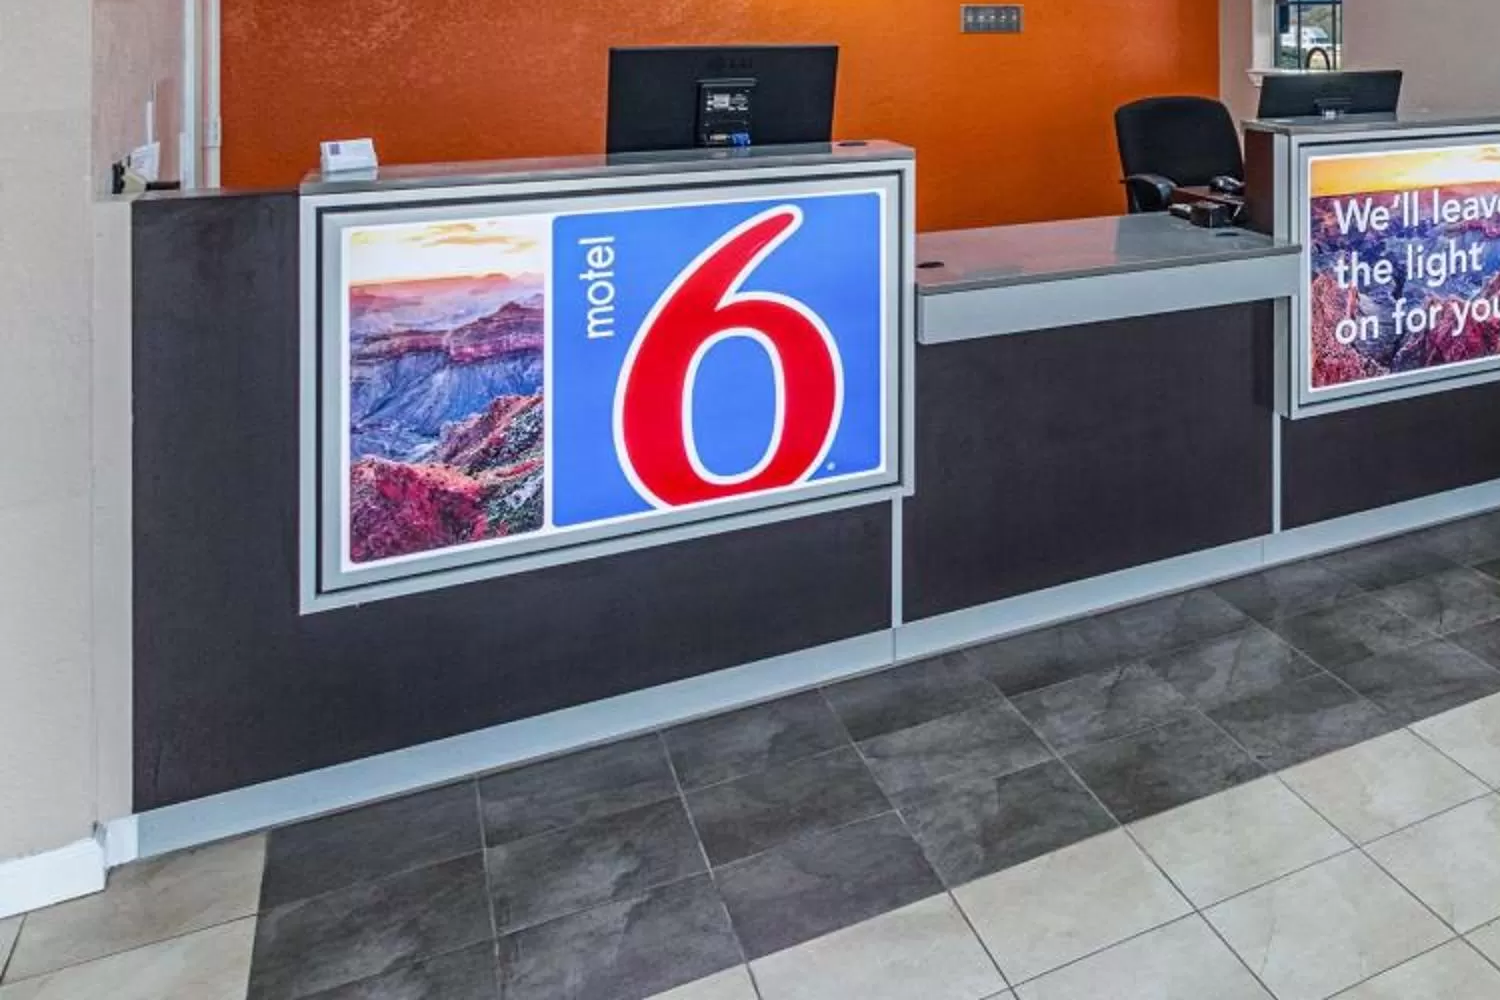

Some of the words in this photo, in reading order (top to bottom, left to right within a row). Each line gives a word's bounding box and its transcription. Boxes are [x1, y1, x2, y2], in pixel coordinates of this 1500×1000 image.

[1333, 251, 1394, 289] the
[1407, 240, 1485, 287] light
[1335, 315, 1380, 345] on
[1392, 298, 1443, 335] for
[578, 236, 616, 340] motel
[611, 203, 845, 511] 6
